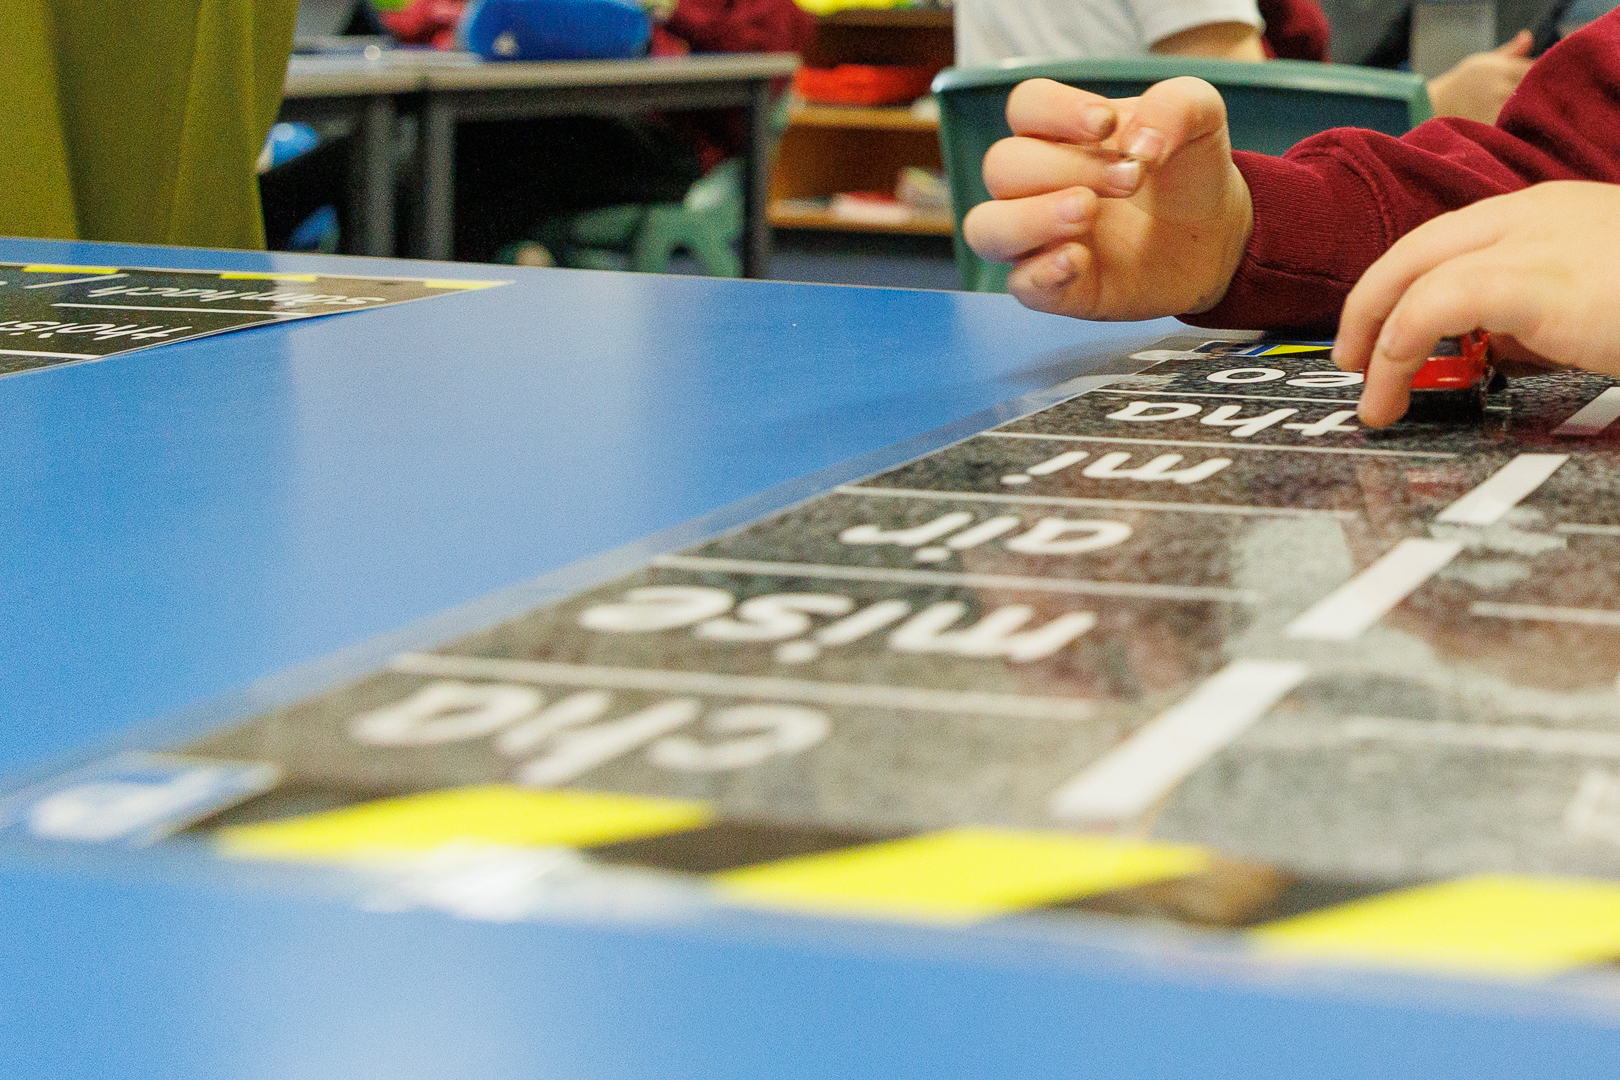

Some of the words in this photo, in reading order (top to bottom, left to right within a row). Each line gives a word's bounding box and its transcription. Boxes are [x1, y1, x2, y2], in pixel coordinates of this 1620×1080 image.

[1105, 401, 1360, 438] tha
[1001, 449, 1234, 485] mi
[839, 511, 1134, 563] air
[577, 584, 1099, 664] mise
[348, 679, 833, 787] cha
